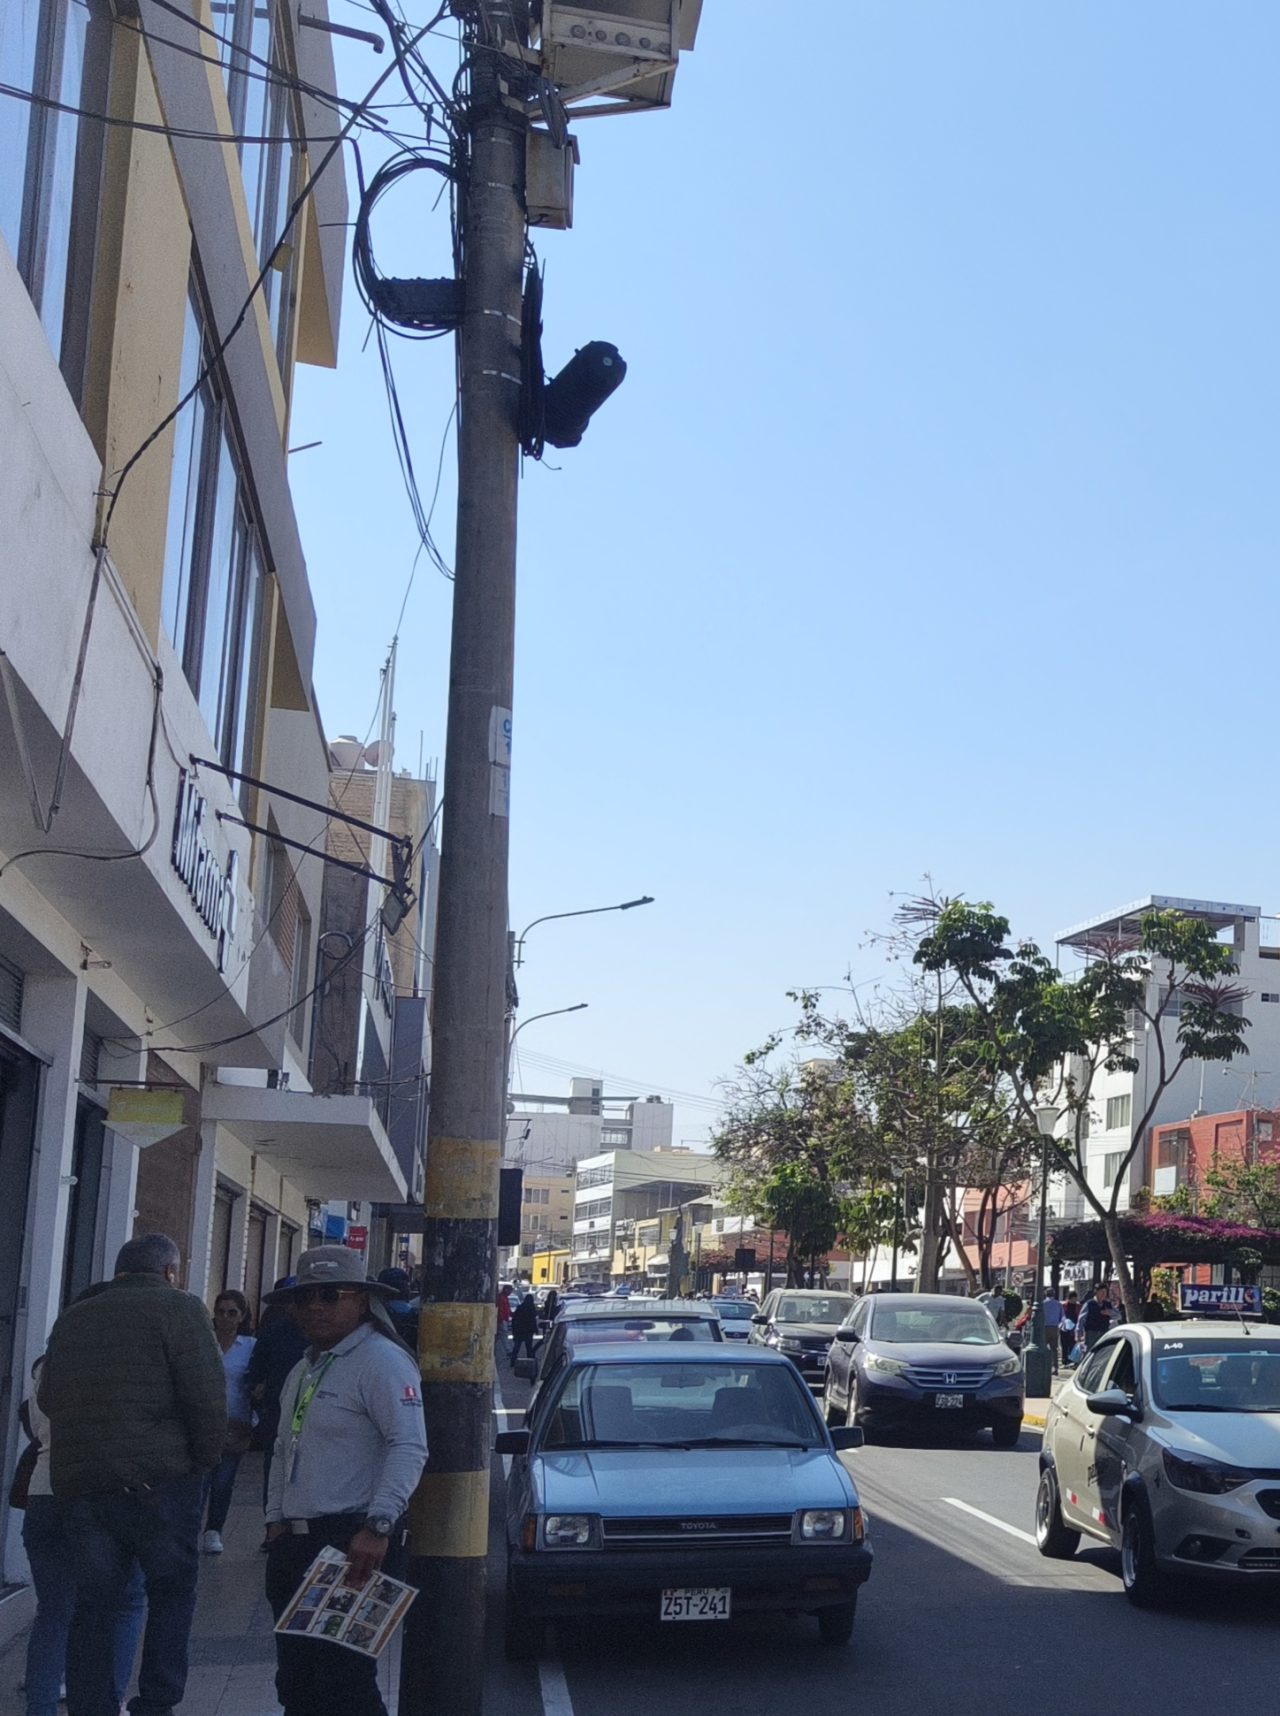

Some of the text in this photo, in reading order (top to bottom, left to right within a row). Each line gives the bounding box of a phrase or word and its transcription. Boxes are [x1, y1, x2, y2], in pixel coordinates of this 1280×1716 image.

[171, 768, 227, 940] Mifarma
[1163, 1342, 1184, 1350] A-40
[681, 1522, 717, 1530] TOYOTA
[663, 1595, 727, 1616] Z5T-241
